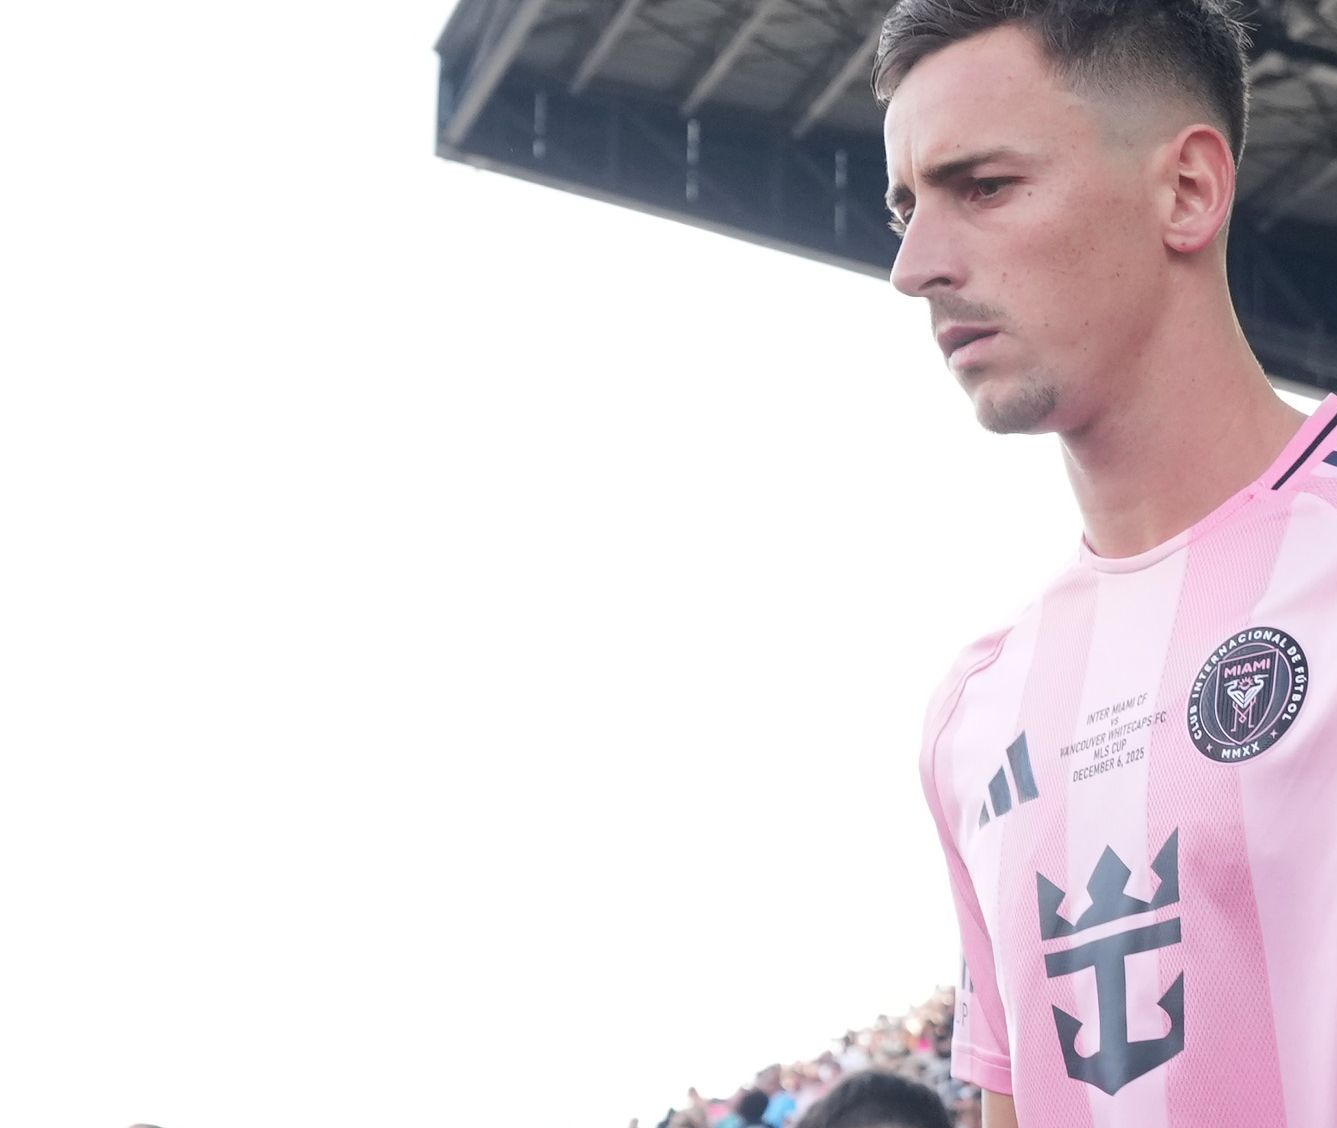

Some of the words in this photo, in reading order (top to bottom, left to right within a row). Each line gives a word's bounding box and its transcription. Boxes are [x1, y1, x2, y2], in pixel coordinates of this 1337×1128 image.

[1192, 630, 1287, 698] INTERNACIONAL
[1224, 658, 1271, 678] MIAMI
[1287, 646, 1301, 663] DE
[1087, 707, 1110, 726] INTER
[1112, 696, 1135, 715] MIAMI
[1137, 693, 1148, 706] CF
[1190, 706, 1202, 740] CLUB
[1060, 732, 1106, 758] VANCOUVER
[1108, 715, 1153, 740] WHITECAPS
[1155, 711, 1167, 724] FC
[1094, 745, 1109, 760] MLS
[1112, 739, 1127, 754] CUP
[1221, 741, 1260, 759] MMXX
[1073, 757, 1114, 782] DECEMBER
[1126, 747, 1144, 764] 2025
